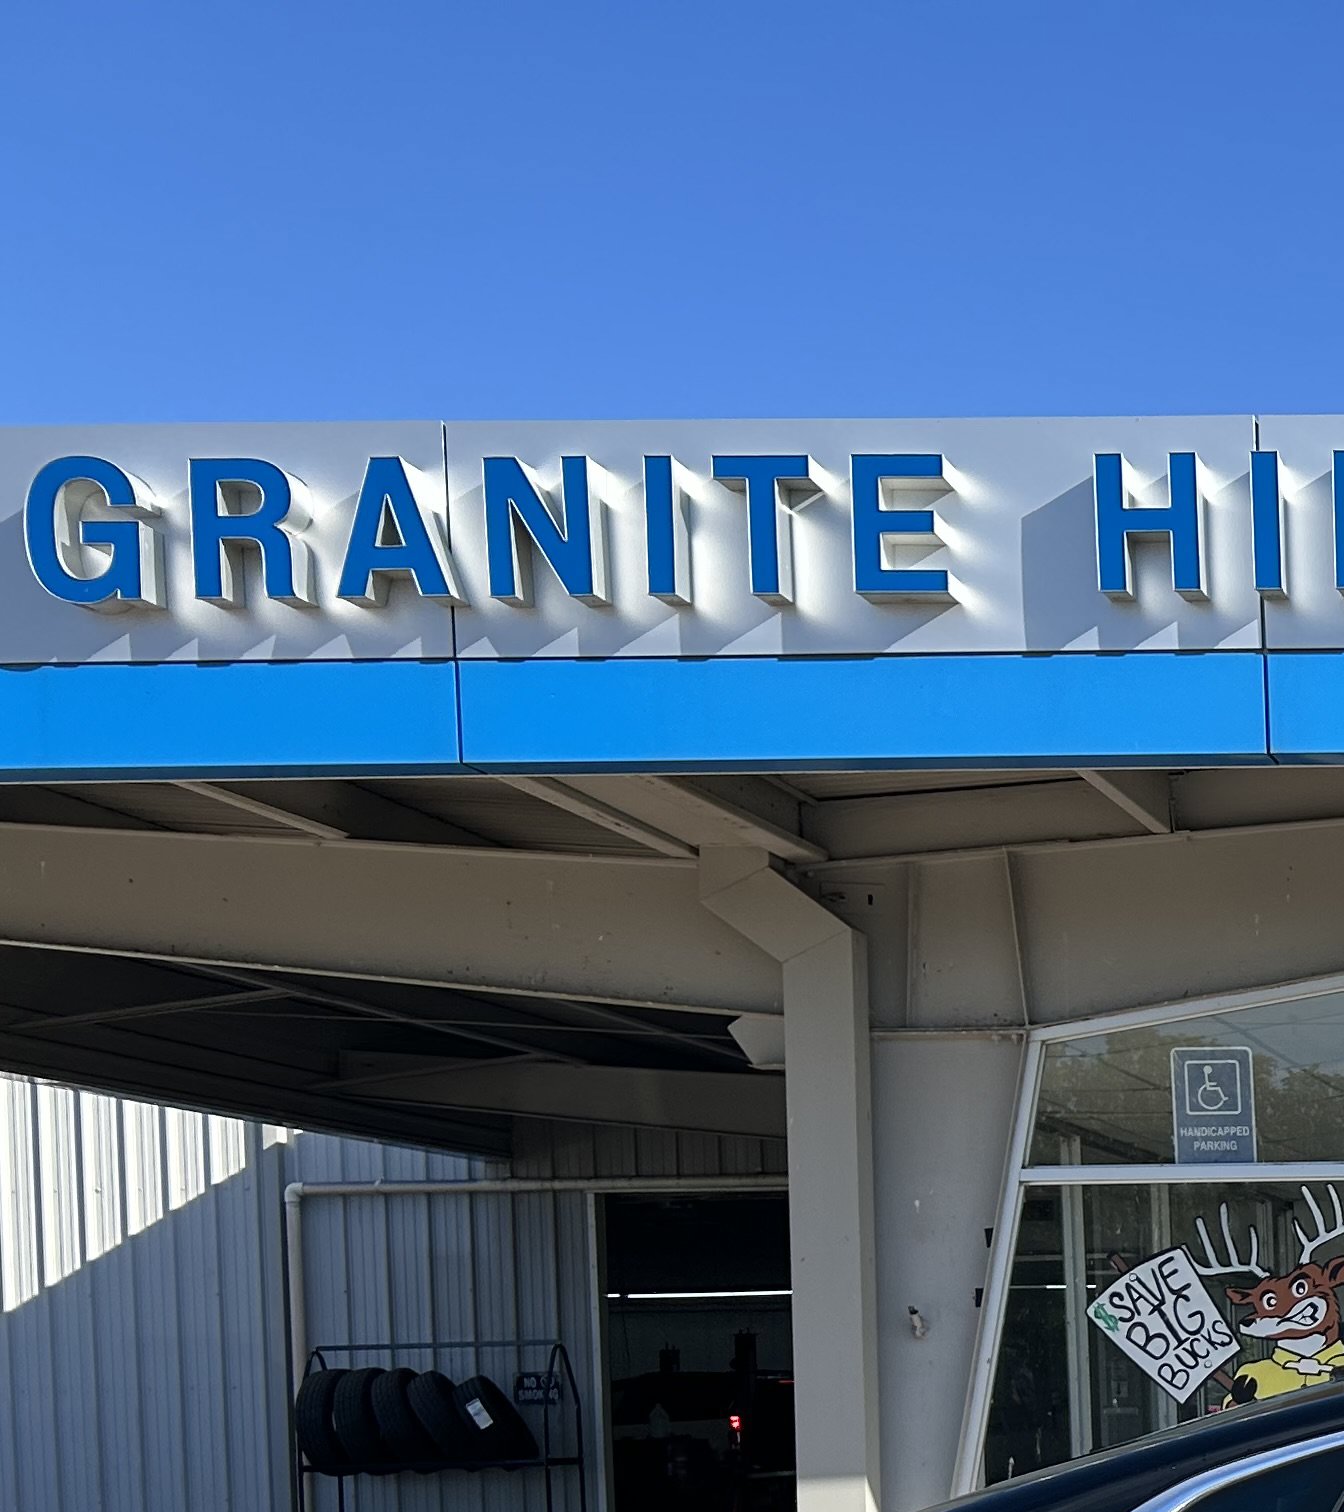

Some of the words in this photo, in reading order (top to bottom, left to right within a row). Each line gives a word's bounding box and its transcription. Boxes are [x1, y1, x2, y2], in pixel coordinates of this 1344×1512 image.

[25, 453, 952, 606] GRANITE
[1180, 1126, 1250, 1137] HANDICAPPED
[1193, 1141, 1238, 1151] PARKING
[1108, 1256, 1192, 1323] SAVE
[1125, 1294, 1206, 1360] BIG
[1157, 1319, 1234, 1391] BUCKS
[518, 1388, 559, 1401] SMOKNG
[523, 1377, 537, 1388] NO
